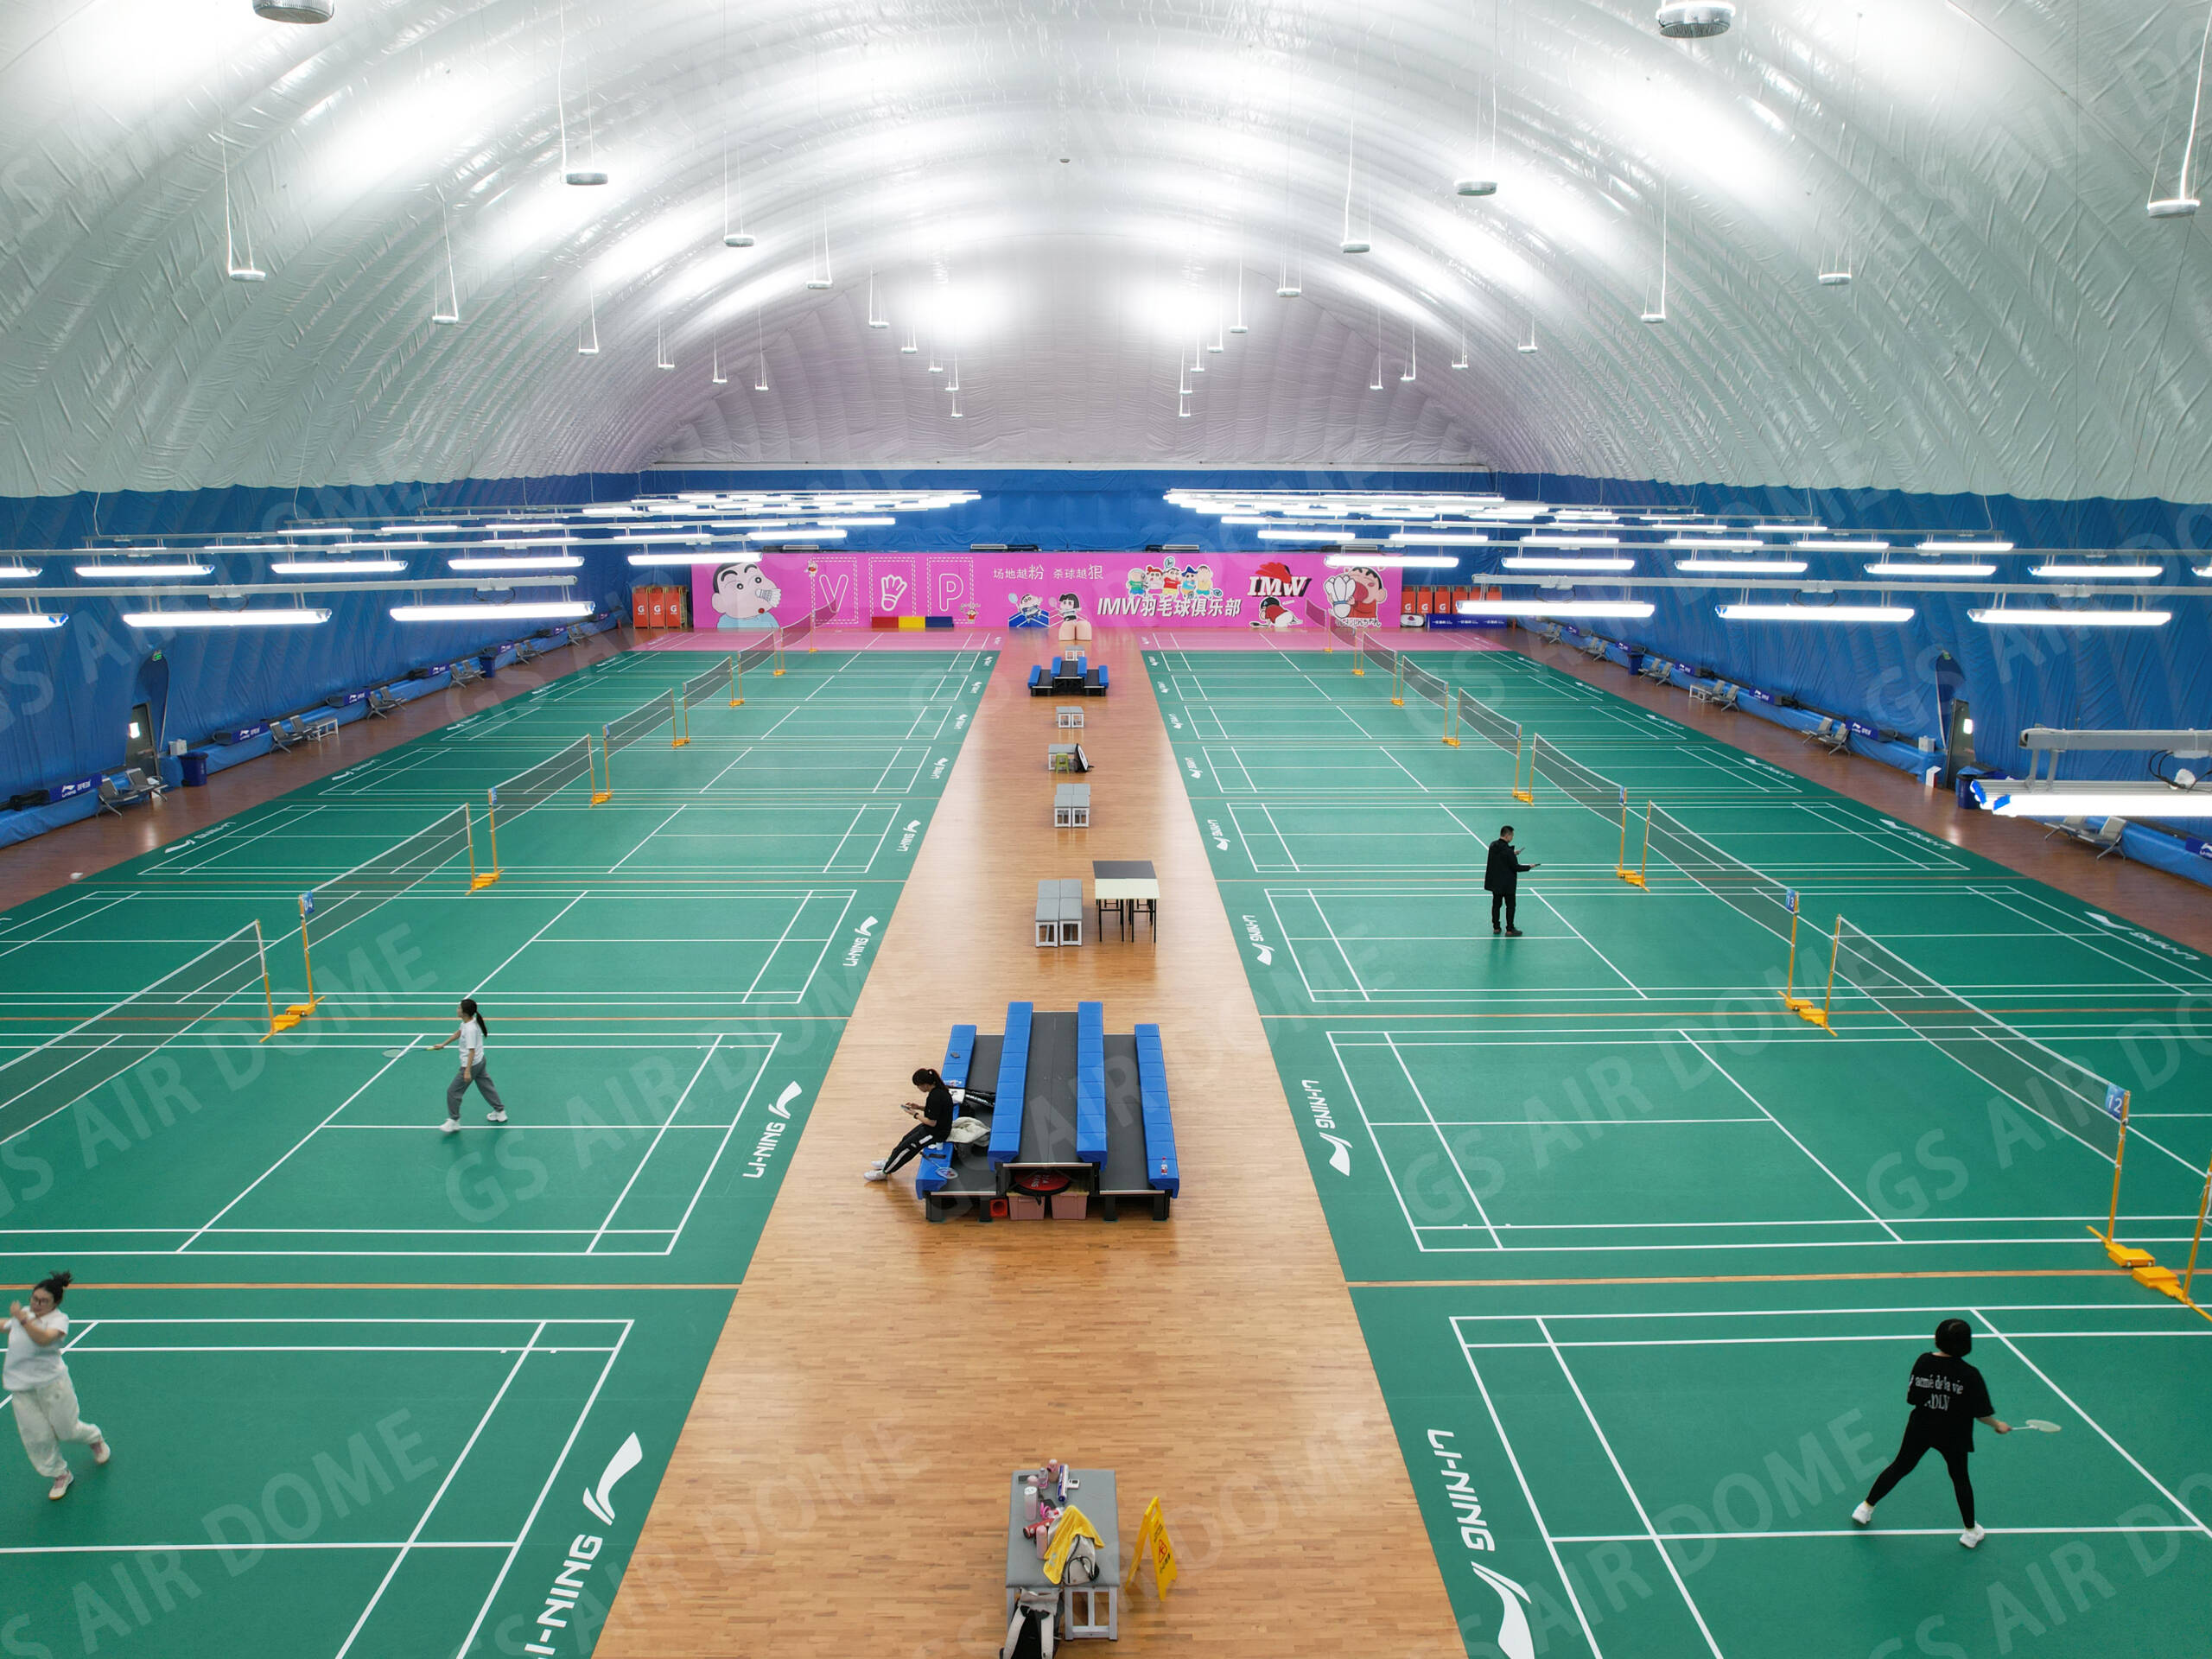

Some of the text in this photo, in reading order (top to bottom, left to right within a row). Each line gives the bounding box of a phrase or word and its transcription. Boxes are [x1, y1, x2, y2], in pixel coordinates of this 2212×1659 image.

[993, 564, 1104, 580] 场地越粉 杀球越狠
[1247, 575, 1311, 597] IMW
[819, 573, 963, 613] V P
[1097, 597, 1243, 617] IMW羽毛球俱乐部
[1242, 914, 1264, 942] LI-NING
[842, 937, 869, 967] LI-NING
[1301, 1079, 1336, 1129] LI-NING
[2108, 1095, 2123, 1114] 12
[742, 1122, 786, 1179] LI-NING
[1427, 1428, 1496, 1552] LI-NING
[524, 1534, 603, 1659] I-NING
